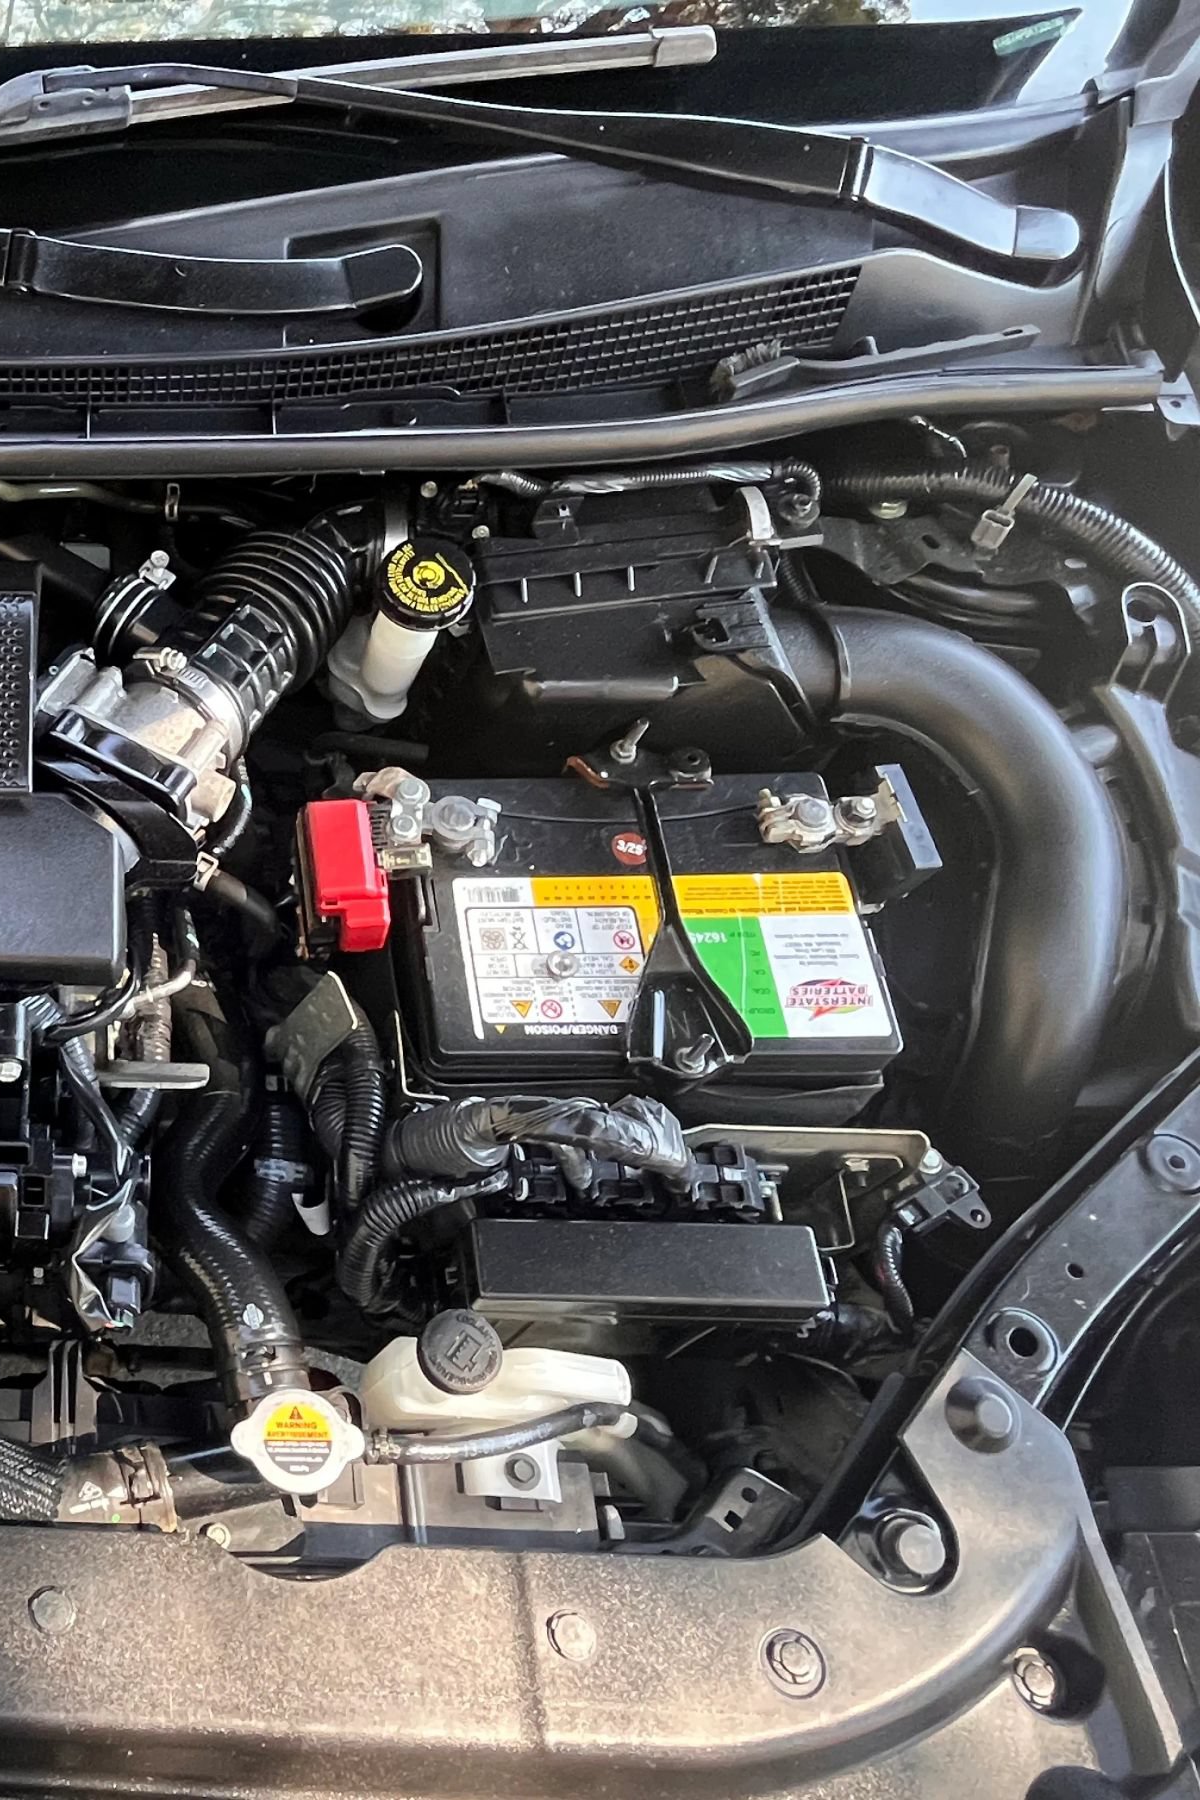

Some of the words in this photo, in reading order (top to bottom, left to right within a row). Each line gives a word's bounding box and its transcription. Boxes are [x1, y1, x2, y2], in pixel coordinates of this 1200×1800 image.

[791, 986, 866, 996] BATTERIES
[789, 996, 871, 1007] INTERSTATE
[523, 1024, 618, 1036] DANGER/POISON
[275, 1421, 318, 1430] WARNING
